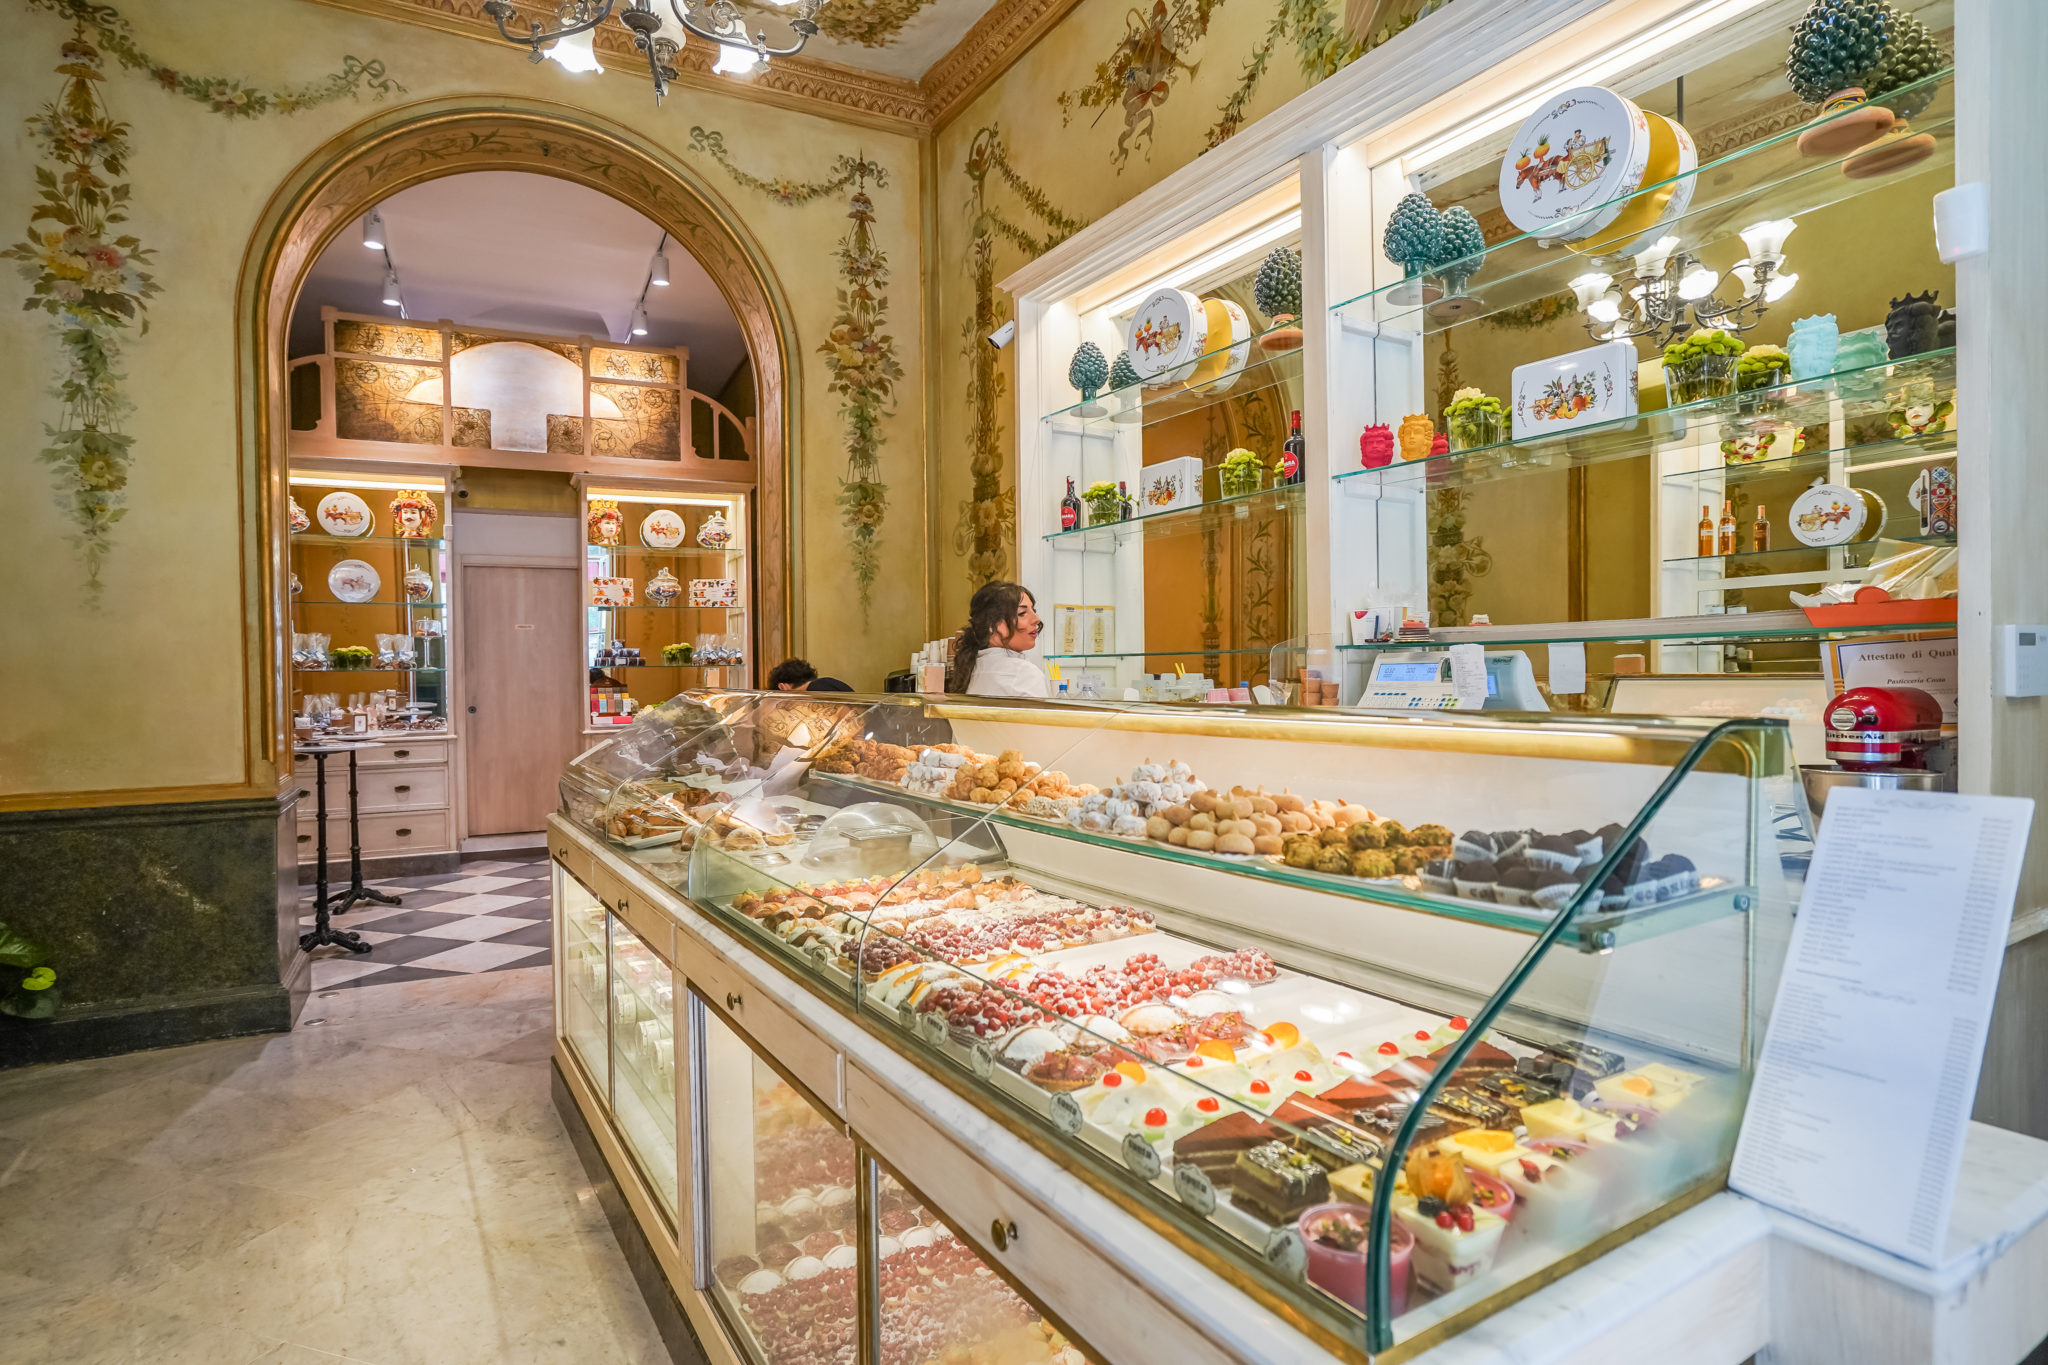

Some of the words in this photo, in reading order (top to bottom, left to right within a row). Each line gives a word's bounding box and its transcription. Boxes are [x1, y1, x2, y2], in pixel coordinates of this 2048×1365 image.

[1859, 652, 1905, 661] Attestato
[1912, 649, 1923, 659] di
[1928, 648, 1958, 659] Qual
[1887, 677, 1925, 685] Pasticceria
